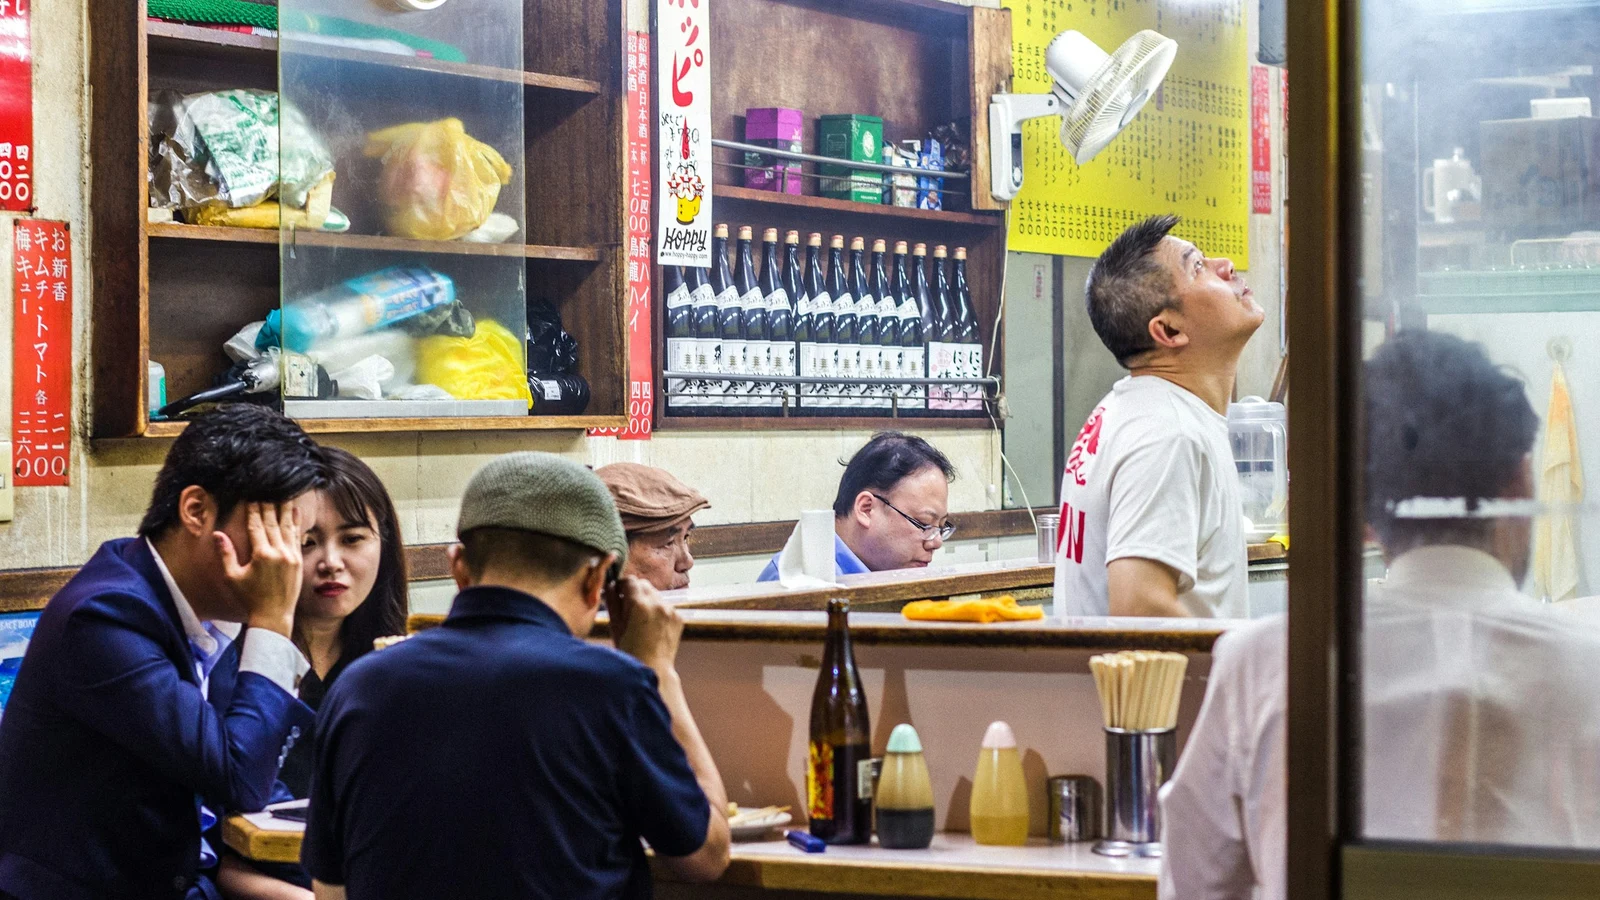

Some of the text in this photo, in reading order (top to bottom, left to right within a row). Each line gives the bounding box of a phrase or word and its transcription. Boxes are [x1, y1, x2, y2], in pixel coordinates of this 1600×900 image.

[627, 35, 638, 92] 紹興酒
[15, 145, 30, 201] 四二〇
[15, 226, 33, 314] 梅キュー
[51, 228, 68, 301] お新香
[629, 381, 641, 435] 四〇〇
[640, 381, 651, 435] 四〇〇
